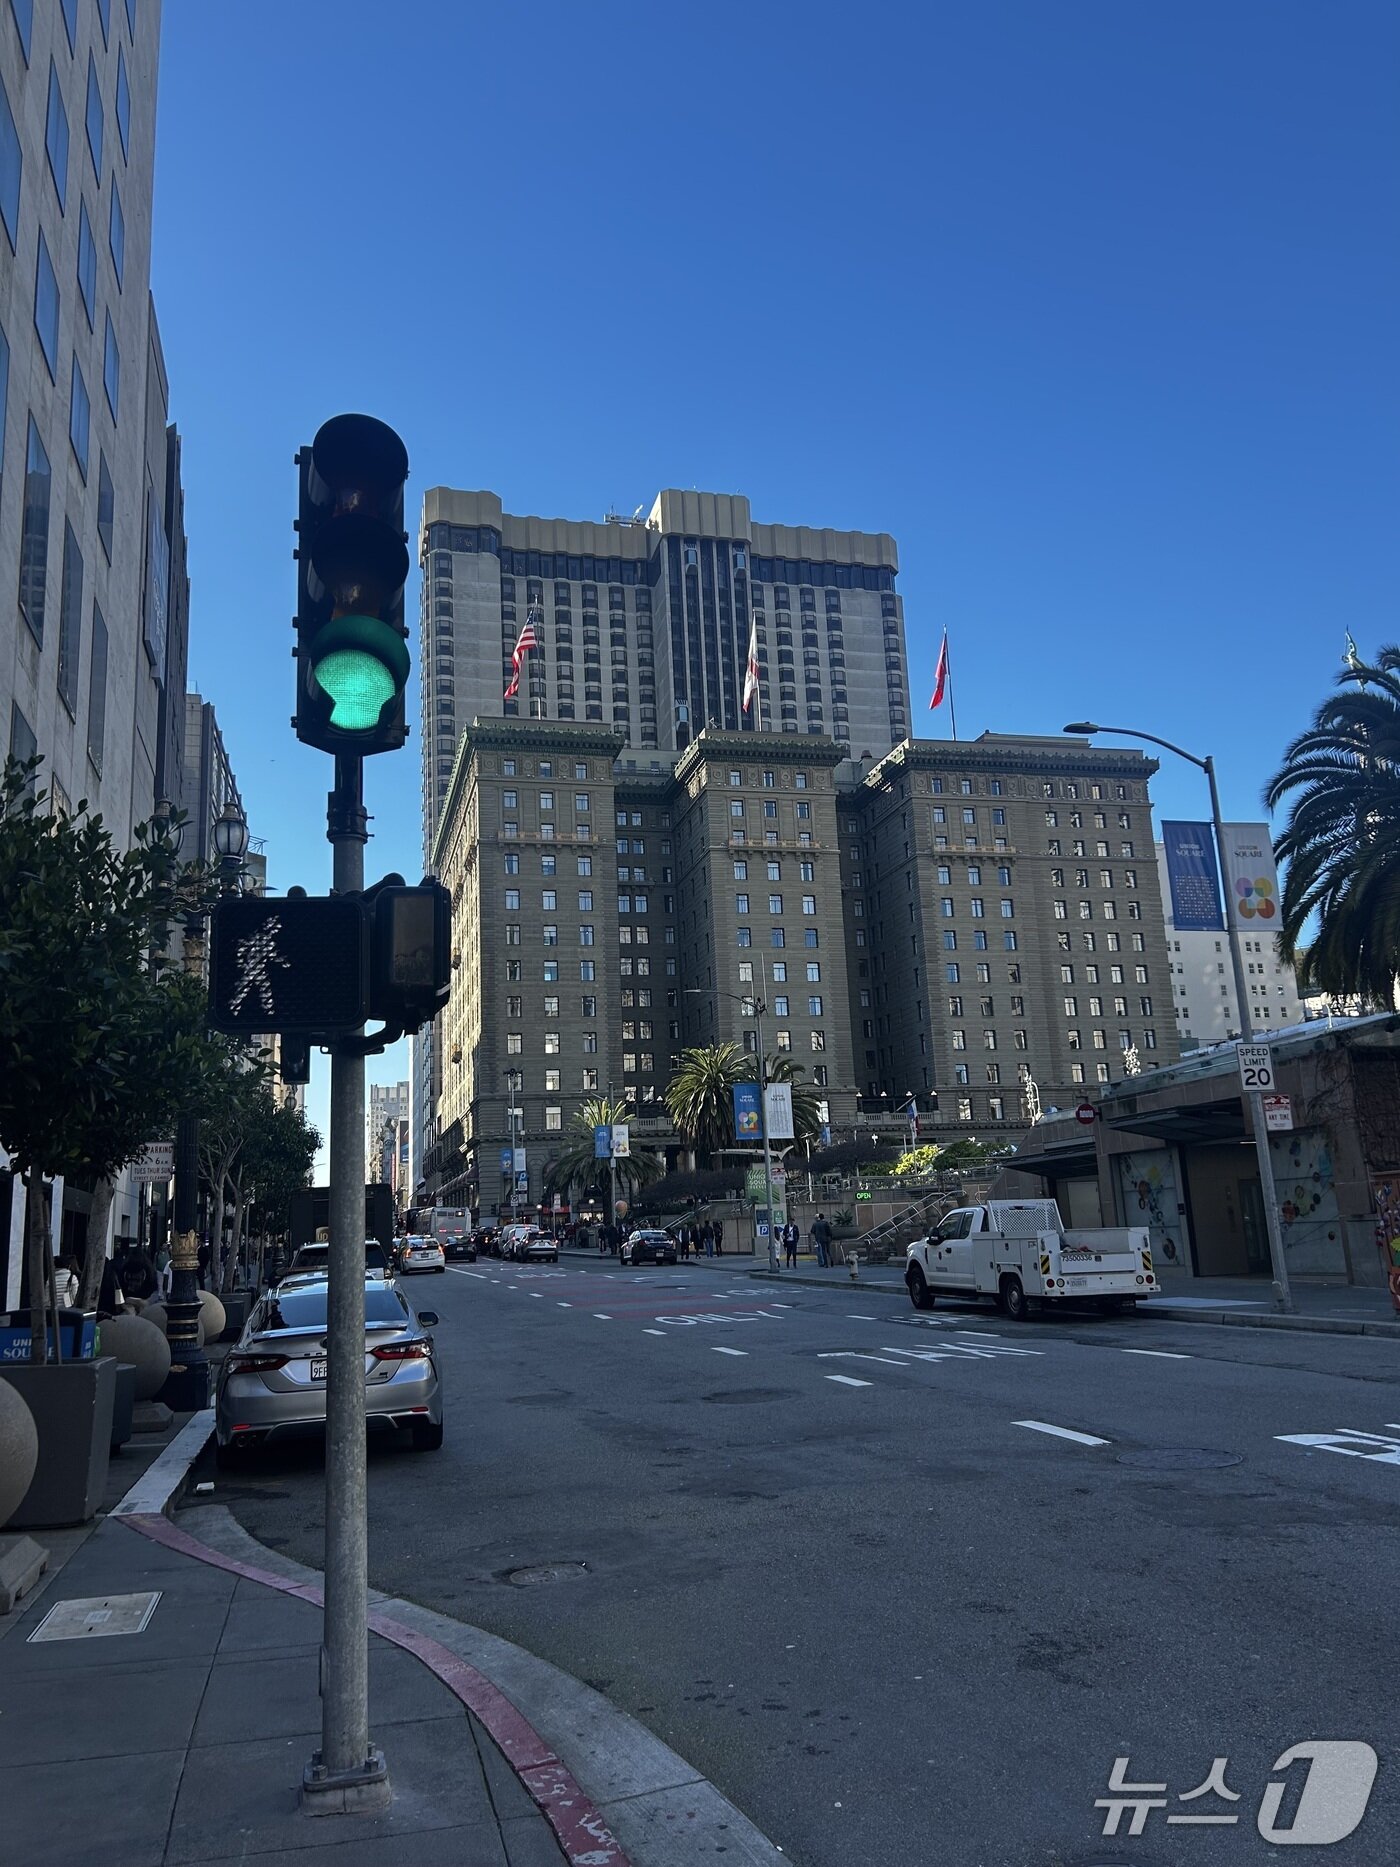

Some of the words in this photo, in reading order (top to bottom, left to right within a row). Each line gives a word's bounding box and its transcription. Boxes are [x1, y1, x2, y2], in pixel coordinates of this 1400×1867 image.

[1175, 849, 1206, 857] SQUARE
[1239, 1048, 1269, 1056] SPEED
[1244, 1058, 1266, 1066] LIMIT
[1243, 1068, 1271, 1086] 20
[654, 1310, 785, 1326] ONLY
